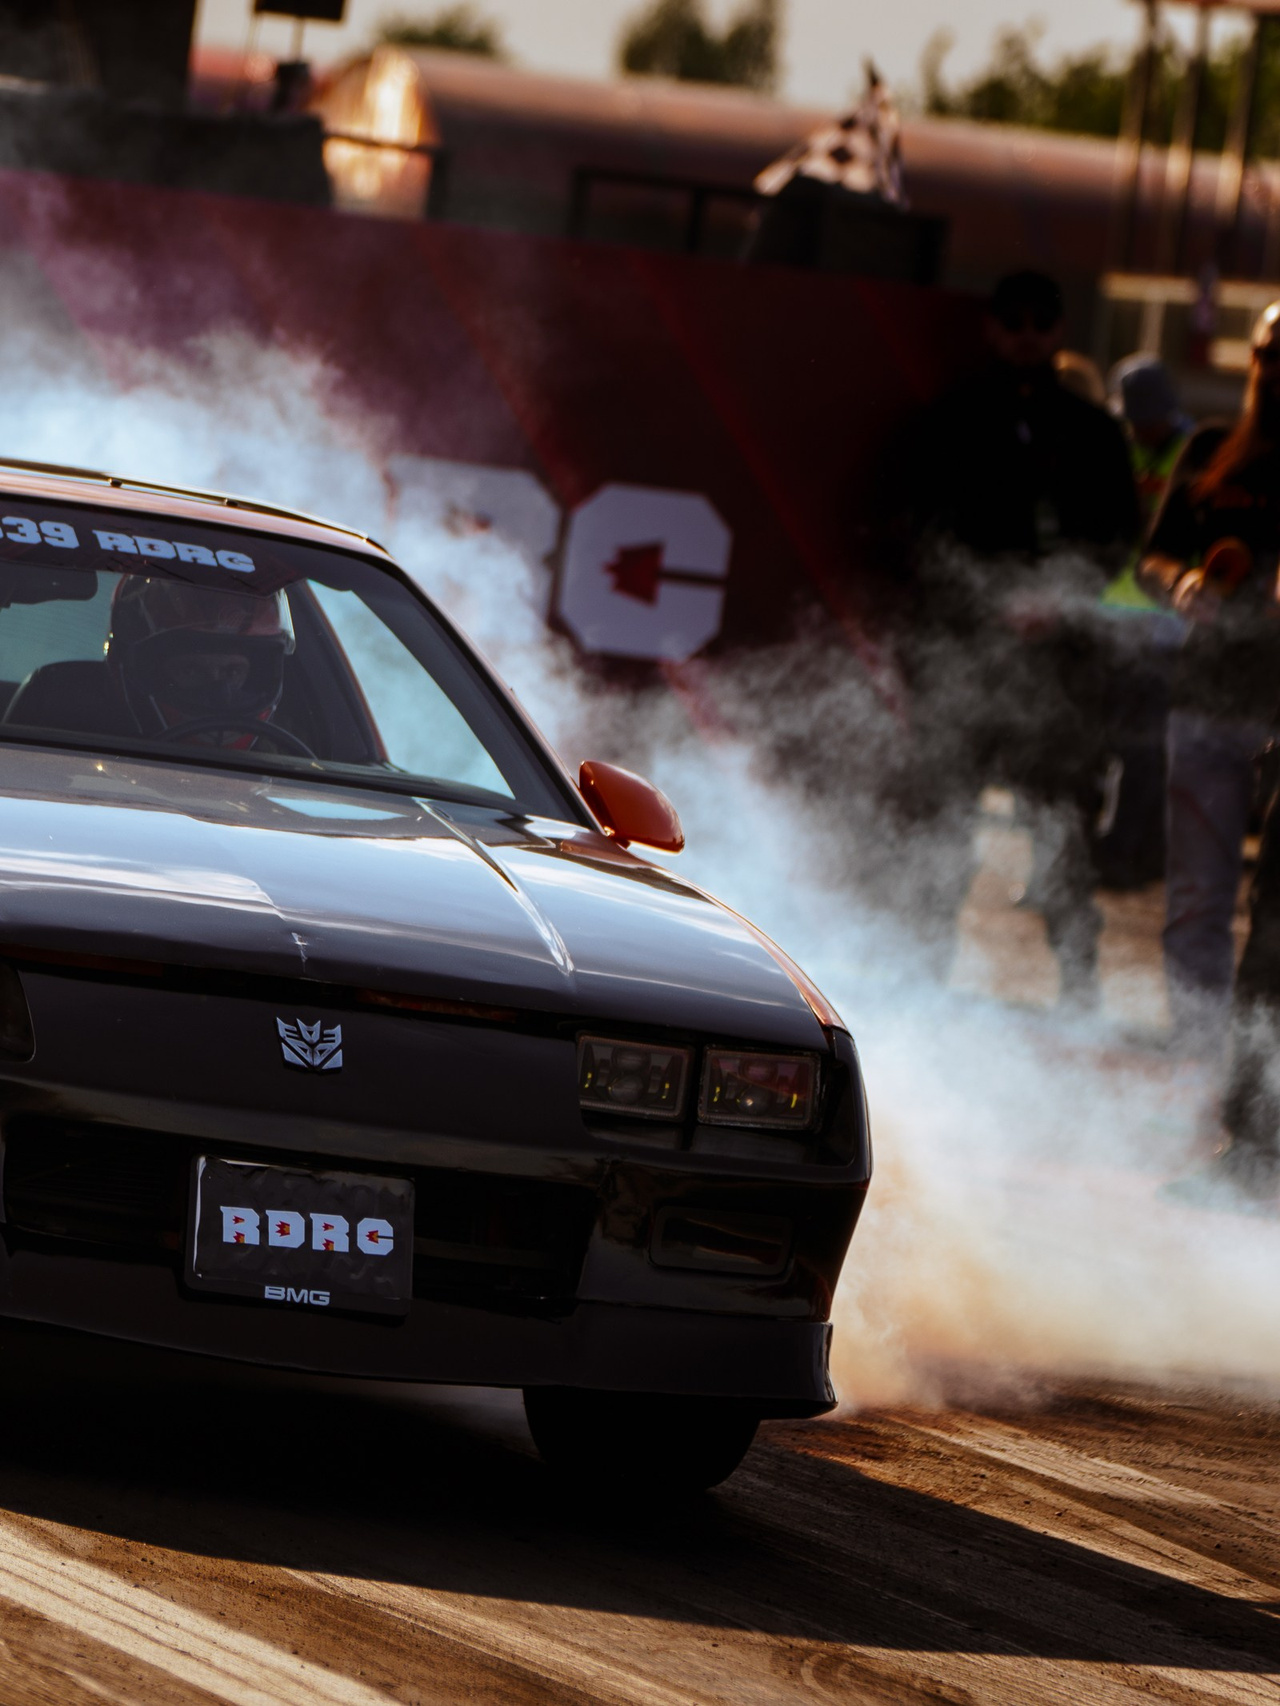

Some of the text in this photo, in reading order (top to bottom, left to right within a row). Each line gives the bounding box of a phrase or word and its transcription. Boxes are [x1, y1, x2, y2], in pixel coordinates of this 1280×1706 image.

[92, 529, 256, 573] RDRC
[220, 1206, 395, 1256] RDRC
[264, 1285, 331, 1306] BMG
